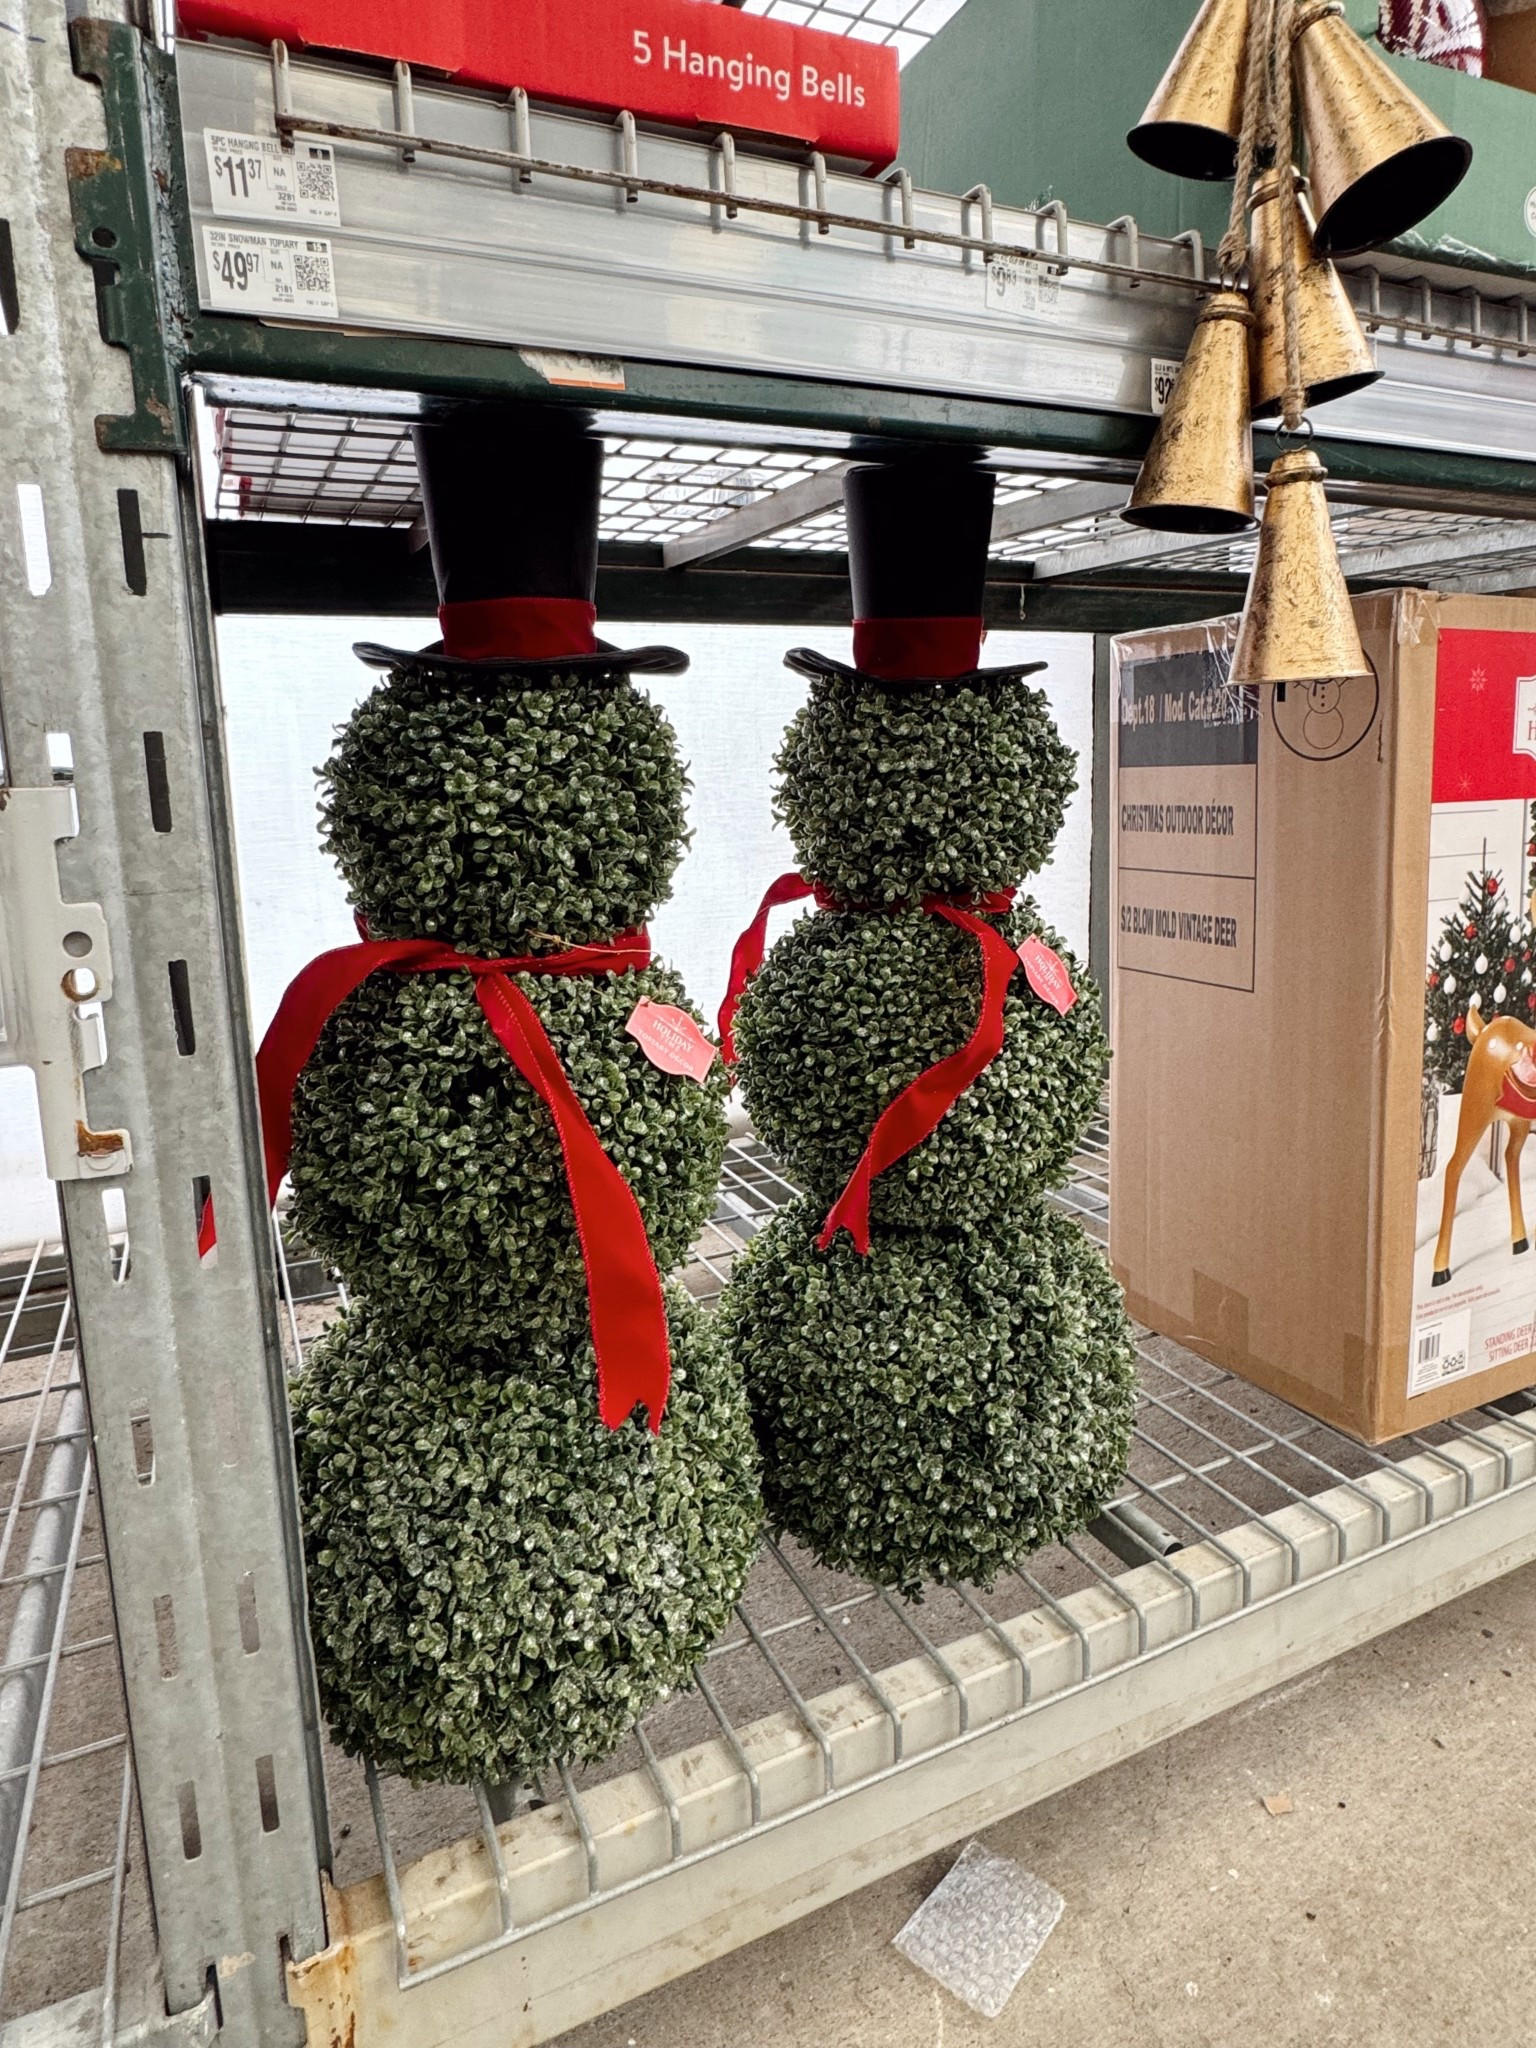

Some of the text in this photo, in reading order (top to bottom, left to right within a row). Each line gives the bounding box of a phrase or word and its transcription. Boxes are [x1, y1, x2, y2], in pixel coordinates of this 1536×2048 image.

[633, 29, 866, 108] 5 Hanging Bells
[211, 135, 226, 147] 5PC
[228, 138, 260, 152] HANGNG
[262, 142, 280, 154] BELL
[273, 167, 286, 178] NA
[210, 231, 298, 250] 32IN SNOWMAN TOPIARY
[270, 260, 283, 271] NA
[1164, 693, 1186, 722] Mod.
[1121, 798, 1234, 836] CHRISTMAS OUTDOOR DÉCOR
[1133, 906, 1154, 936] BLOW
[1155, 909, 1177, 939] MOLD
[1178, 911, 1213, 945] VINTAGE
[1214, 916, 1237, 948] DEER
[1035, 954, 1062, 990] HOLIDAY
[651, 1019, 694, 1053] HOLIDAY
[1484, 1328, 1516, 1350] STANDING
[1516, 1323, 1532, 1339] DEER
[1488, 1338, 1529, 1363] SITTING DEER
